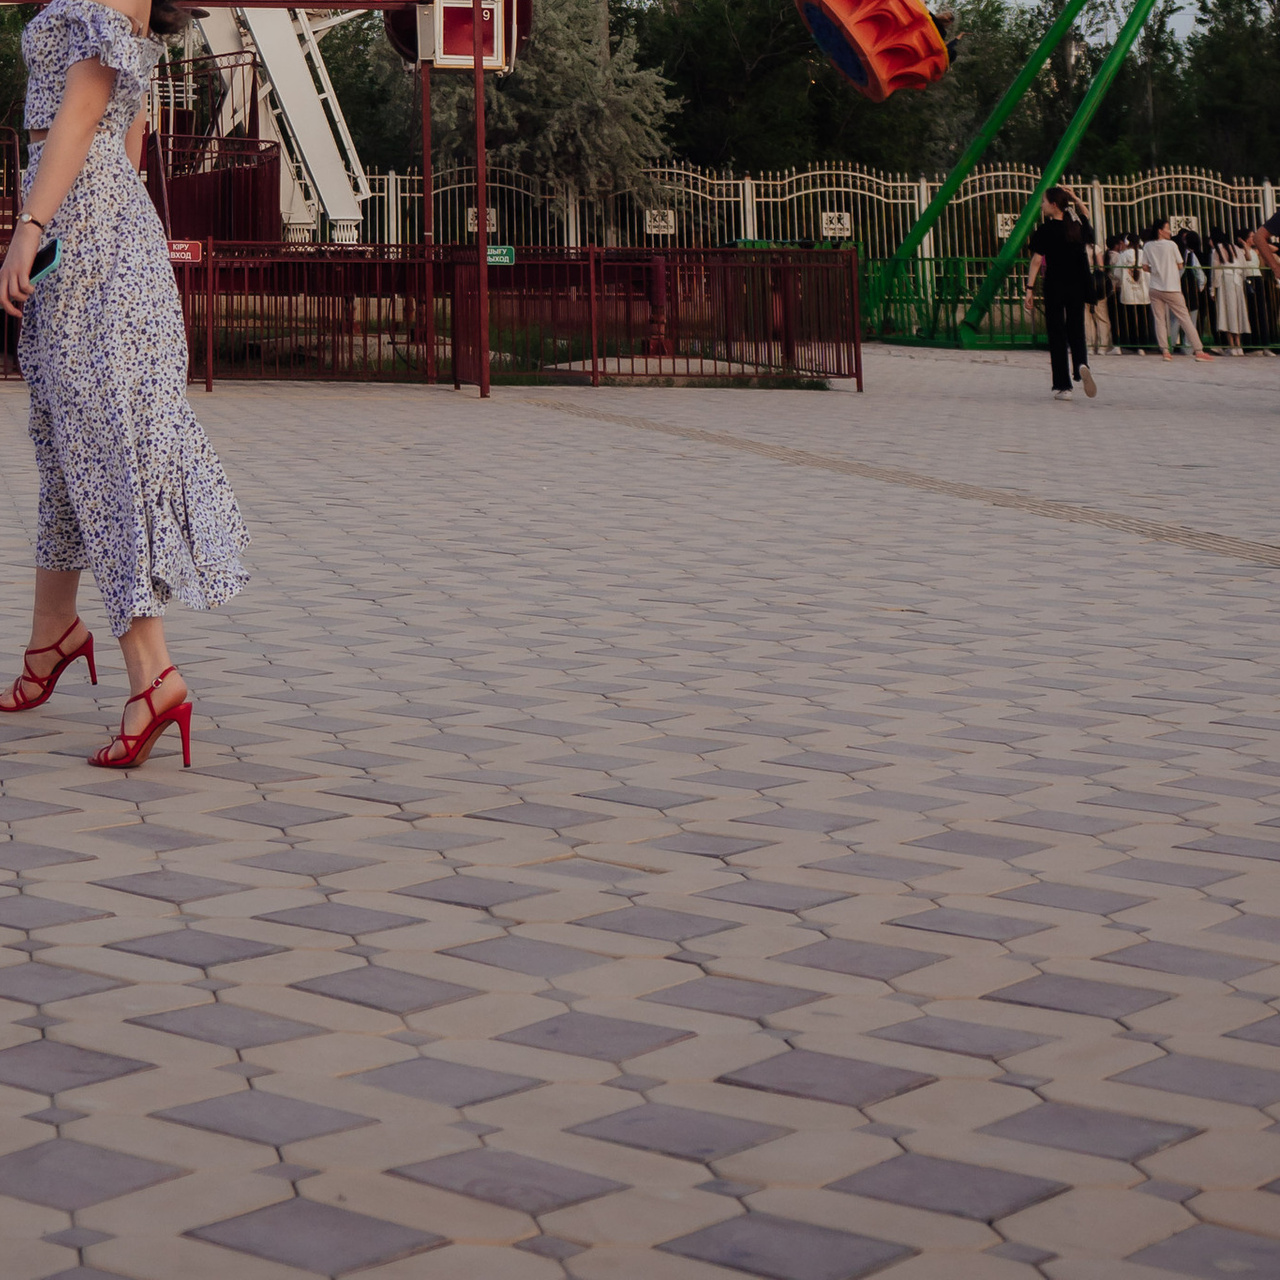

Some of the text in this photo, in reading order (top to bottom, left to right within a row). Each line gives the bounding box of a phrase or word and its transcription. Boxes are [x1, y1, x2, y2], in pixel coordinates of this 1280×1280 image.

[482, 9, 491, 21] 9
[172, 243, 190, 251] КІРУ
[170, 251, 192, 260] ВХОД
